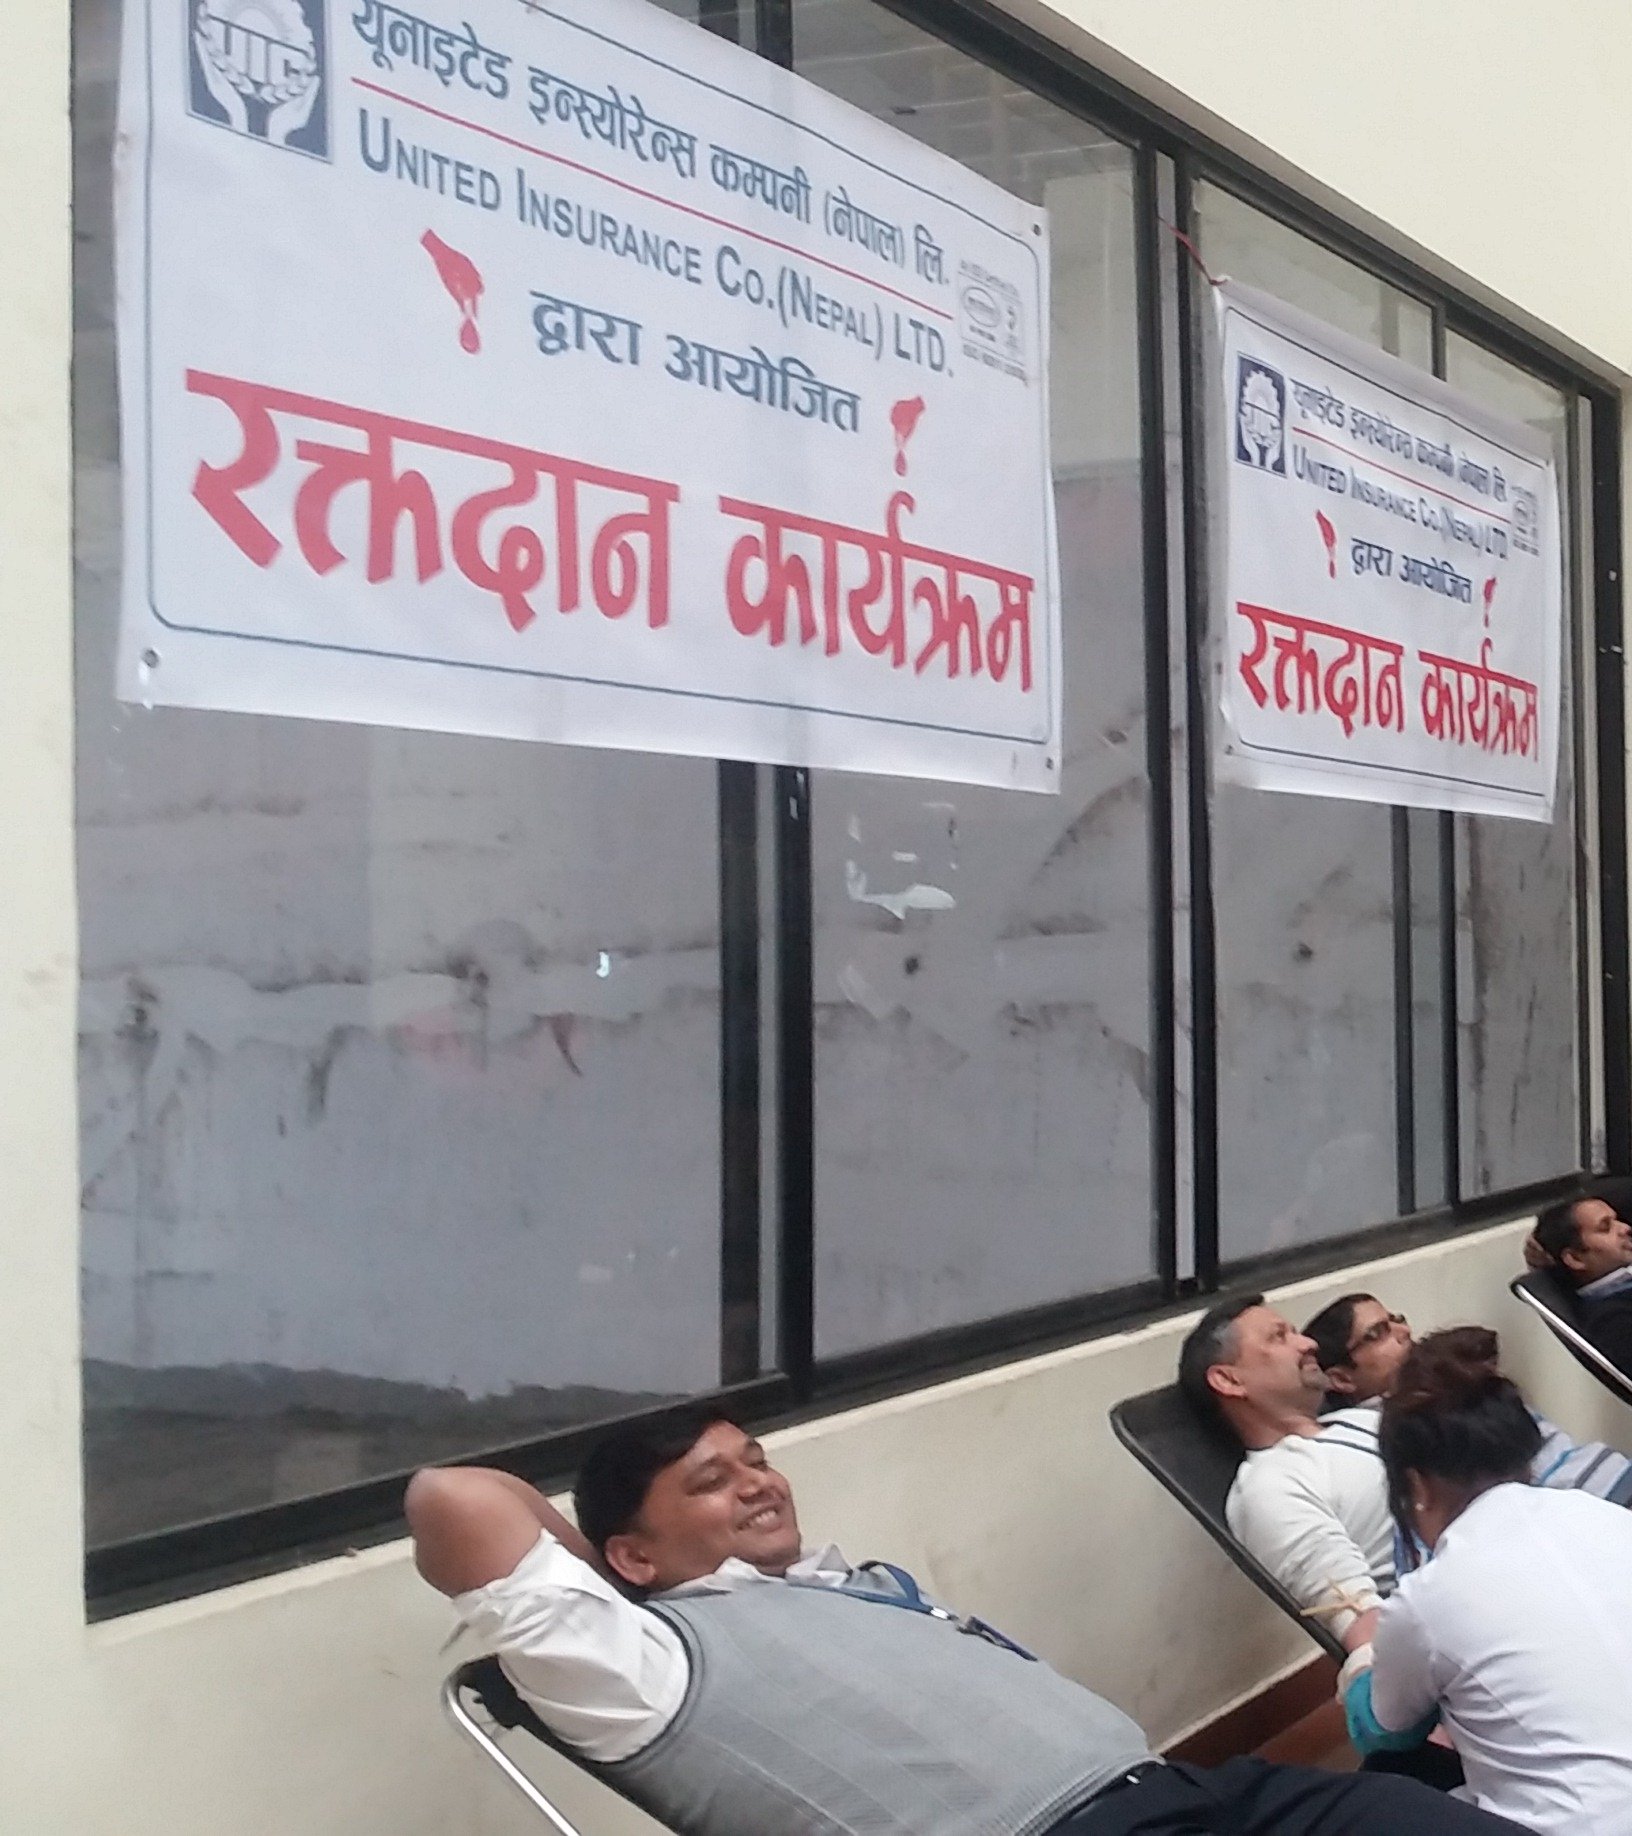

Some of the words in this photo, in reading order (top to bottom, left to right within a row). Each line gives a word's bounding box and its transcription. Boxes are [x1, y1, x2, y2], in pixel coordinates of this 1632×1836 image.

[358, 108, 502, 211] UNITED
[516, 168, 702, 285] INSURANCE
[894, 313, 954, 378] LTD.
[710, 144, 812, 225] कम्पनी
[824, 187, 906, 269] (नेपाल)
[529, 291, 642, 366] द्वारा
[665, 335, 861, 434] आयोजित
[185, 368, 679, 633] रक्तदान
[719, 492, 1034, 692] कार्यक्रम
[1293, 444, 1346, 494] UNITED
[1351, 537, 1393, 577] द्वारा
[1400, 553, 1472, 603] आयोजित
[1236, 601, 1404, 739] रक्तदान
[1418, 637, 1538, 763] कार्यक्रम
